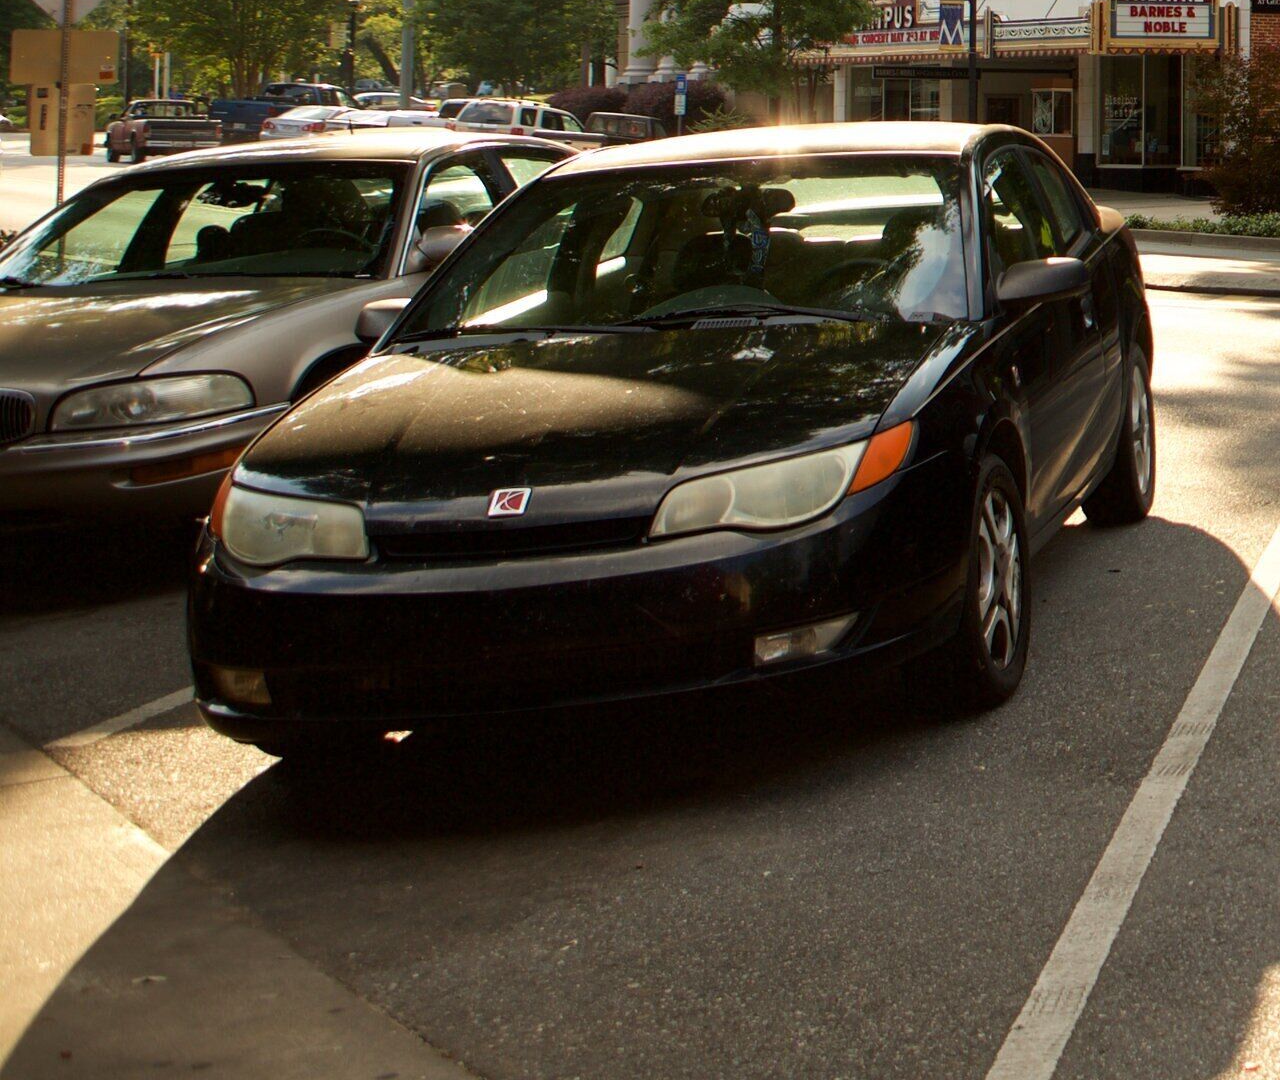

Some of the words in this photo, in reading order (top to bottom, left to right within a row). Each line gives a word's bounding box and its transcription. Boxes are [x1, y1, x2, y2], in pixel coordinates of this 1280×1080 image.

[1130, 6, 1182, 17] BARNES
[1186, 6, 1196, 18] &
[1144, 22, 1187, 33] NOBLE
[919, 30, 927, 41] AT
